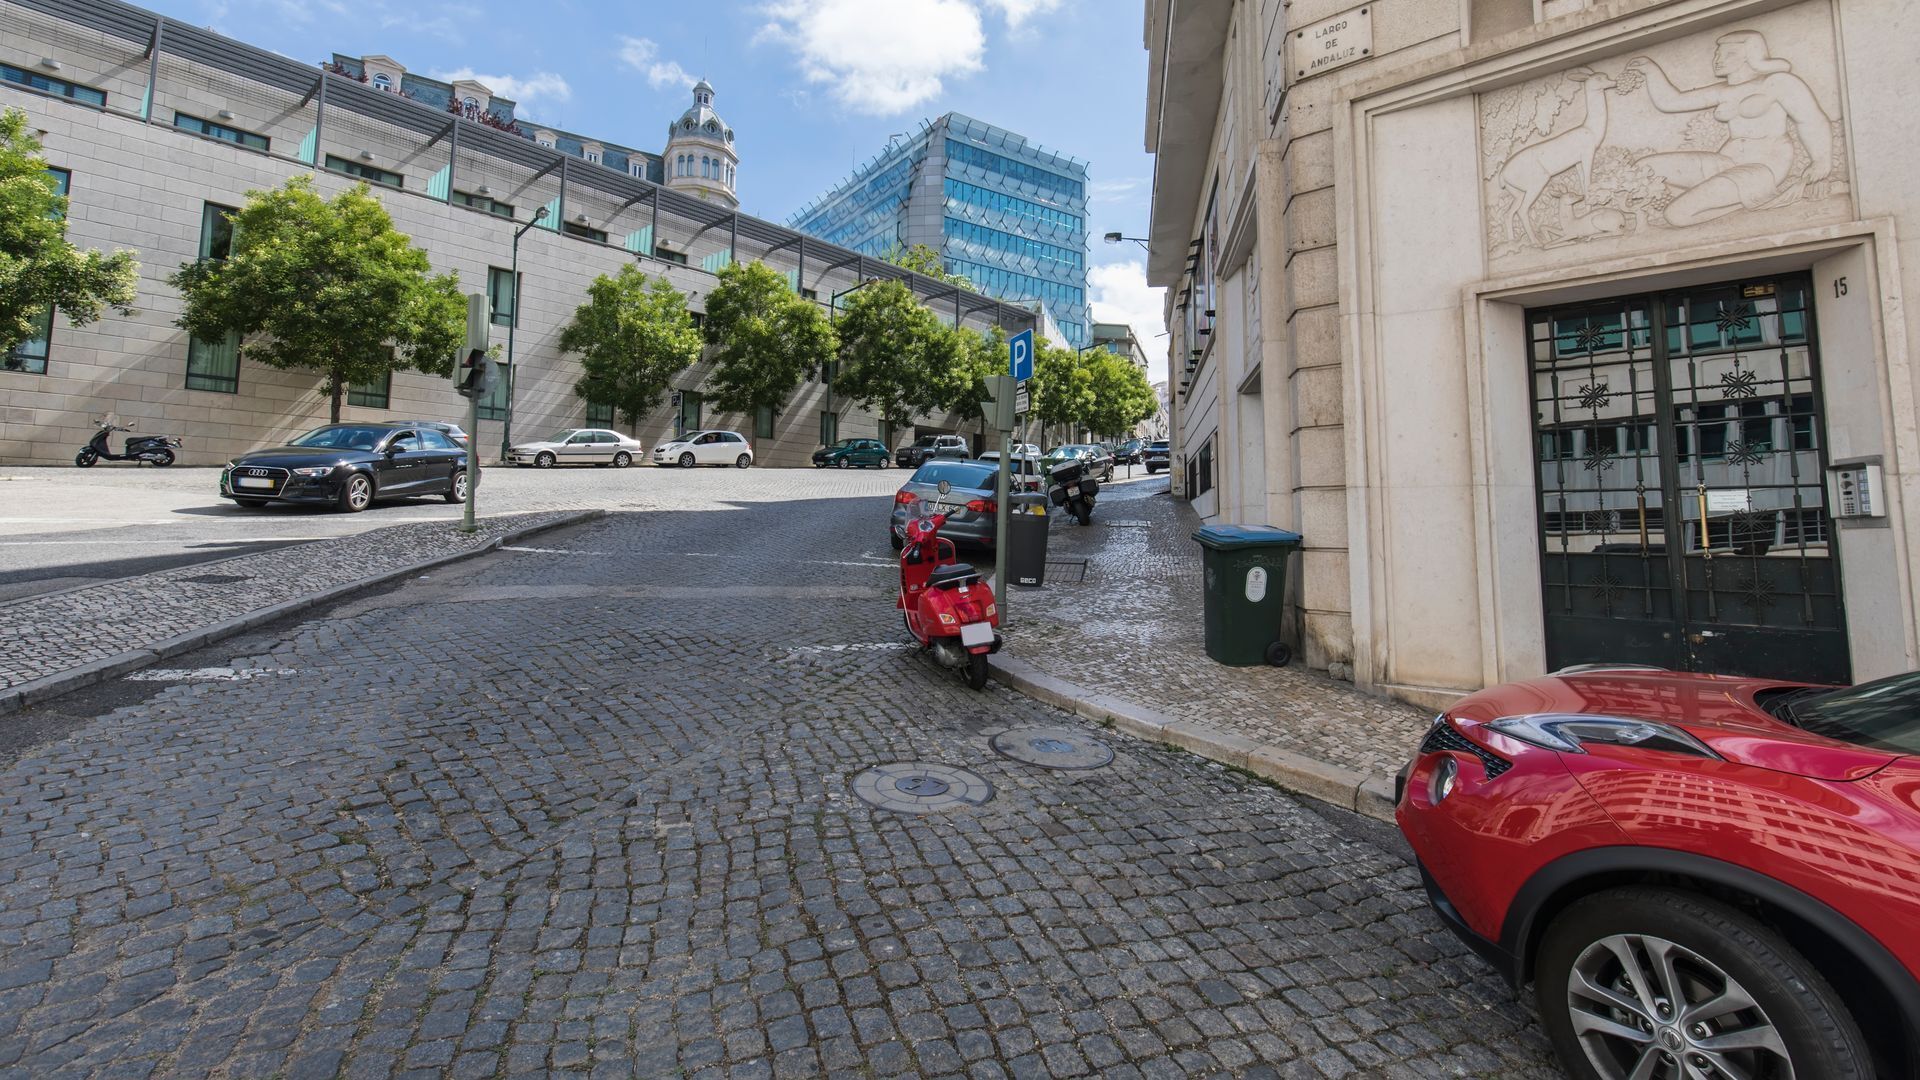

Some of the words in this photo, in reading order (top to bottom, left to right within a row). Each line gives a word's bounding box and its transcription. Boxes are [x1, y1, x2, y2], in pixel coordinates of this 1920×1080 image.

[1315, 20, 1348, 39] LARGO
[1325, 38, 1338, 50] DE
[1310, 46, 1356, 70] ANDALUZ
[1833, 276, 1848, 299] 15
[1014, 339, 1027, 378] P
